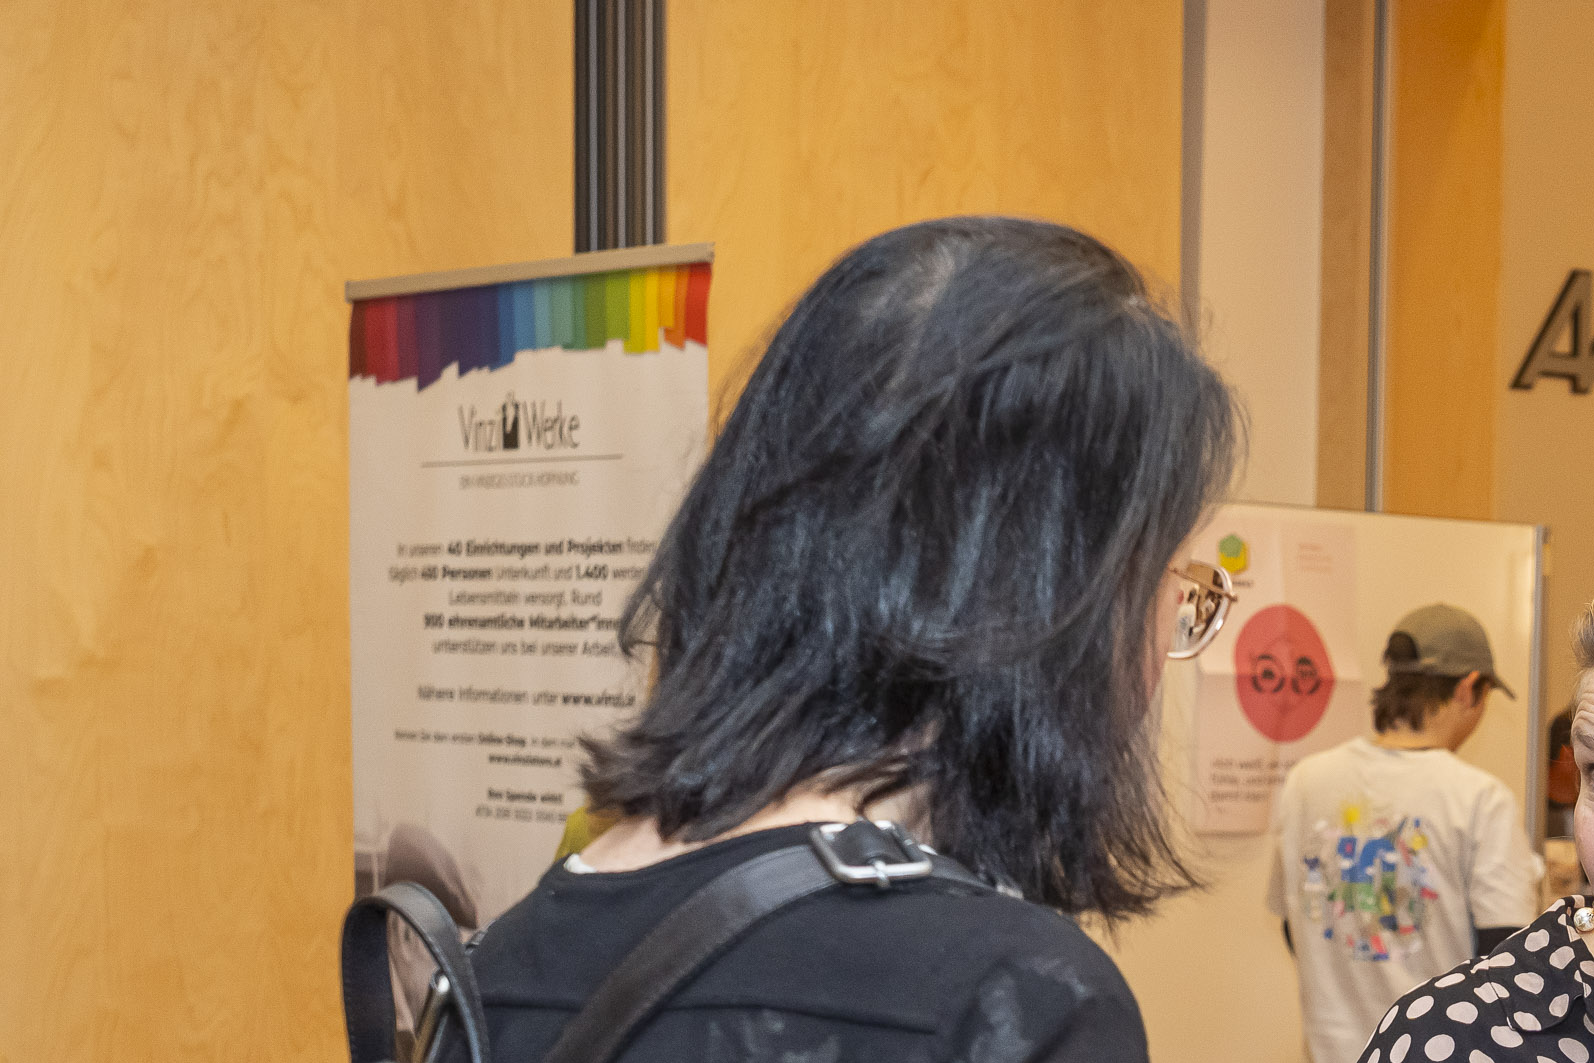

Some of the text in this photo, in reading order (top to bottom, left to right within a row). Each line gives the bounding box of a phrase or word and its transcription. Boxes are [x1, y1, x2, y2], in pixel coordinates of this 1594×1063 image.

[522, 400, 580, 450] Werke
[465, 540, 541, 560] Einrichtungen
[567, 538, 622, 558] Projekten
[442, 564, 492, 580] Personen
[571, 588, 603, 606] Rund
